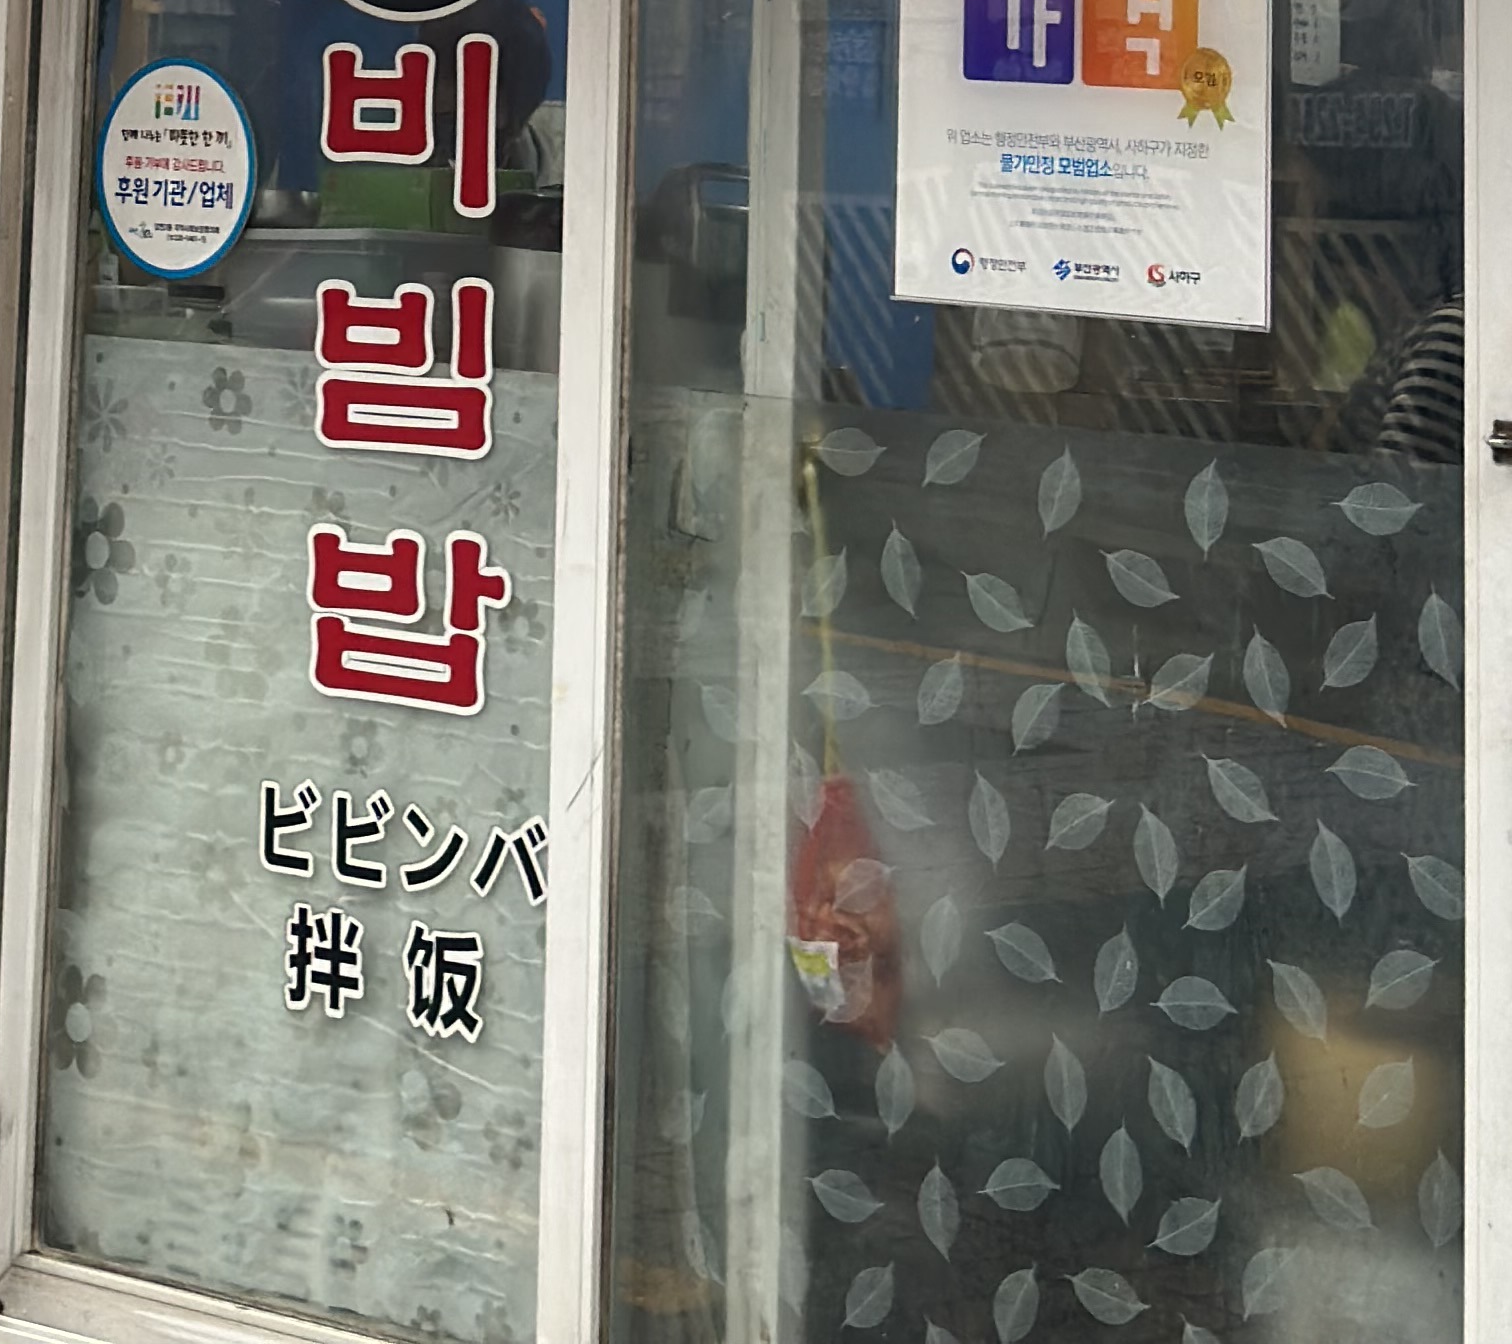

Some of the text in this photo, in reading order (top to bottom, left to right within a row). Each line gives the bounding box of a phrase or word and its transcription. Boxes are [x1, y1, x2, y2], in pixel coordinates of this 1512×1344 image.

[115, 176, 234, 209] 후원 기관/업체
[1168, 270, 1201, 285] 사하구
[308, 38, 509, 712] 비빔밥
[264, 785, 547, 902] ビビンバ
